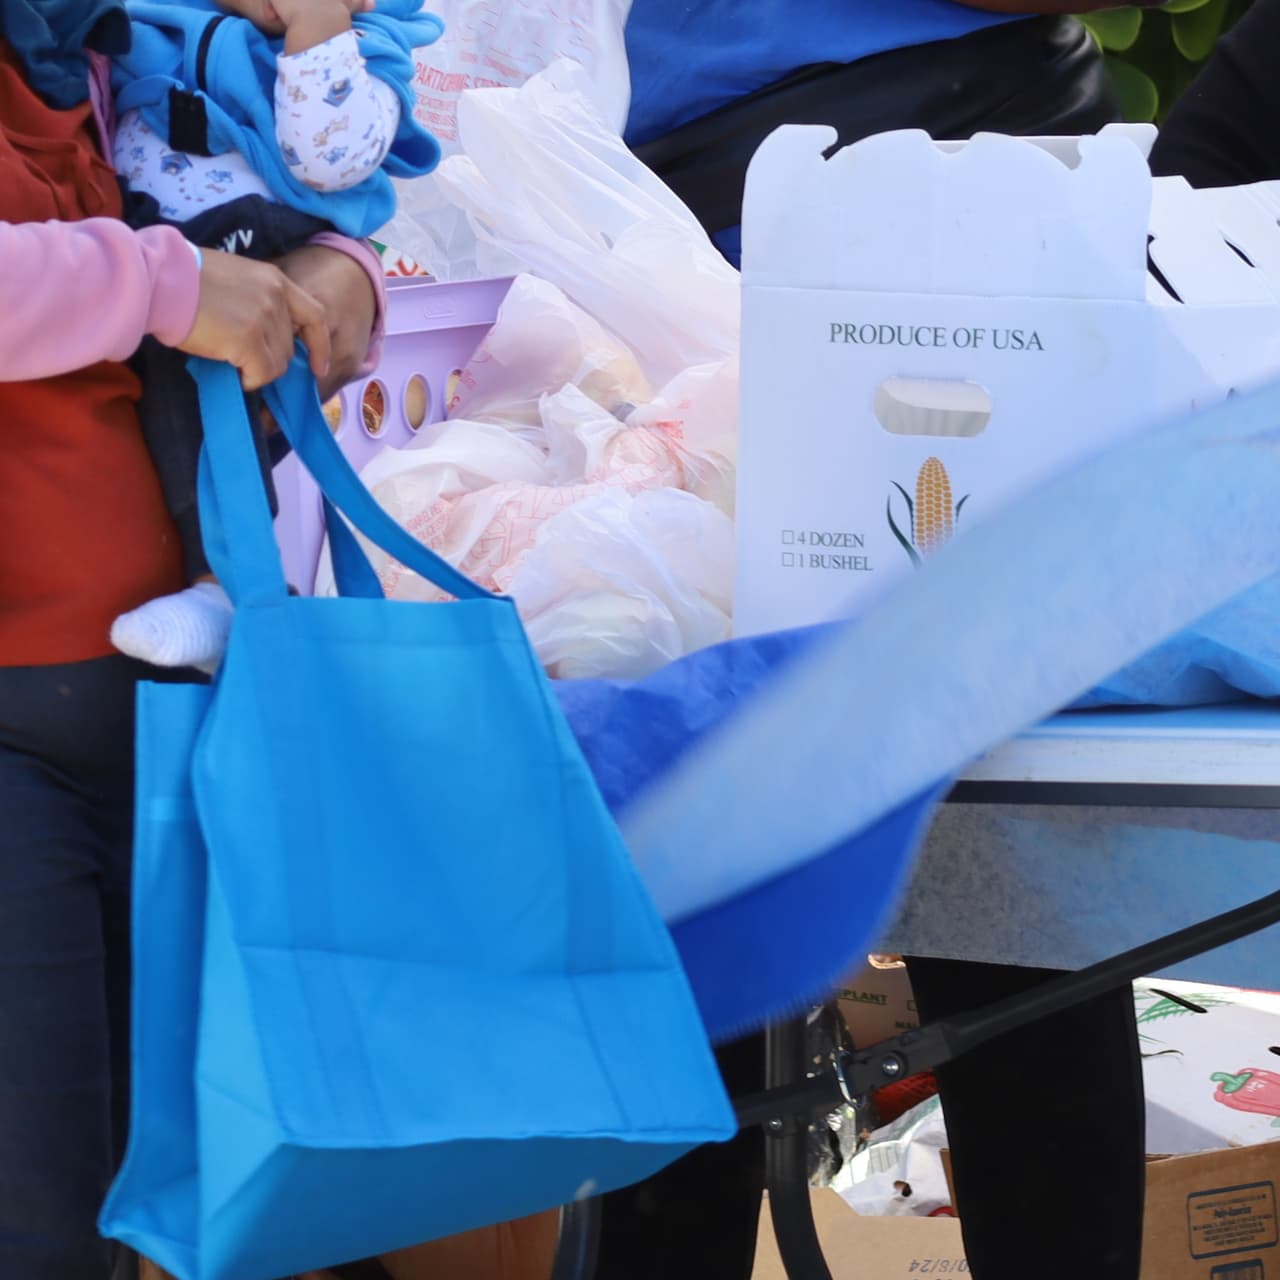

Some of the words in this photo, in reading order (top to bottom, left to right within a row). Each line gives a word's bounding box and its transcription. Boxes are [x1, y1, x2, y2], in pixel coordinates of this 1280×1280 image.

[828, 322, 947, 348] PRODUCE
[952, 327, 987, 349] OF
[992, 329, 1045, 352] USA
[796, 533, 806, 546] 4
[809, 532, 865, 549] DOZEN
[798, 553, 805, 568] 1
[809, 554, 874, 572] BUSHEL
